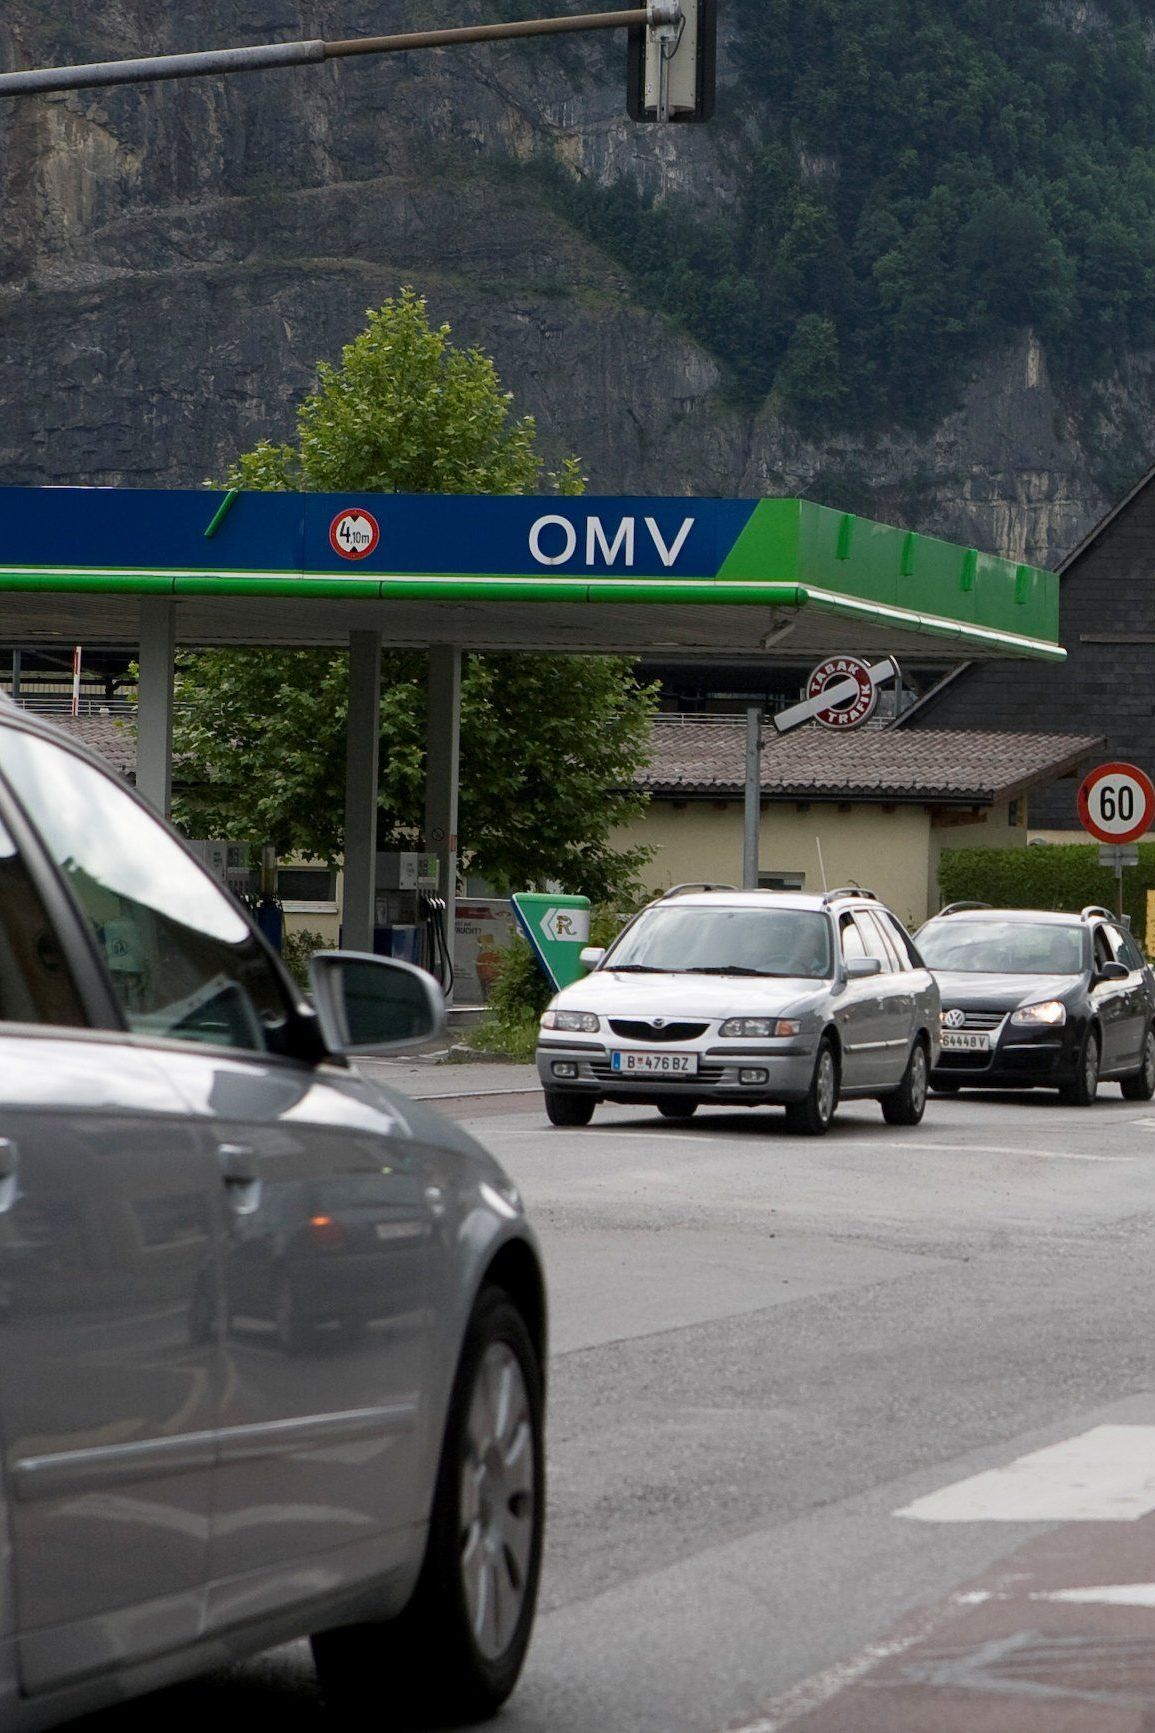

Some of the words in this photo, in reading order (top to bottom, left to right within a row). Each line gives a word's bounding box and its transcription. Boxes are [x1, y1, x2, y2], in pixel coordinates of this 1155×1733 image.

[528, 514, 695, 566] OMV
[811, 660, 860, 692] TABAK
[827, 683, 872, 724] TRAFIK
[1100, 785, 1134, 821] 60
